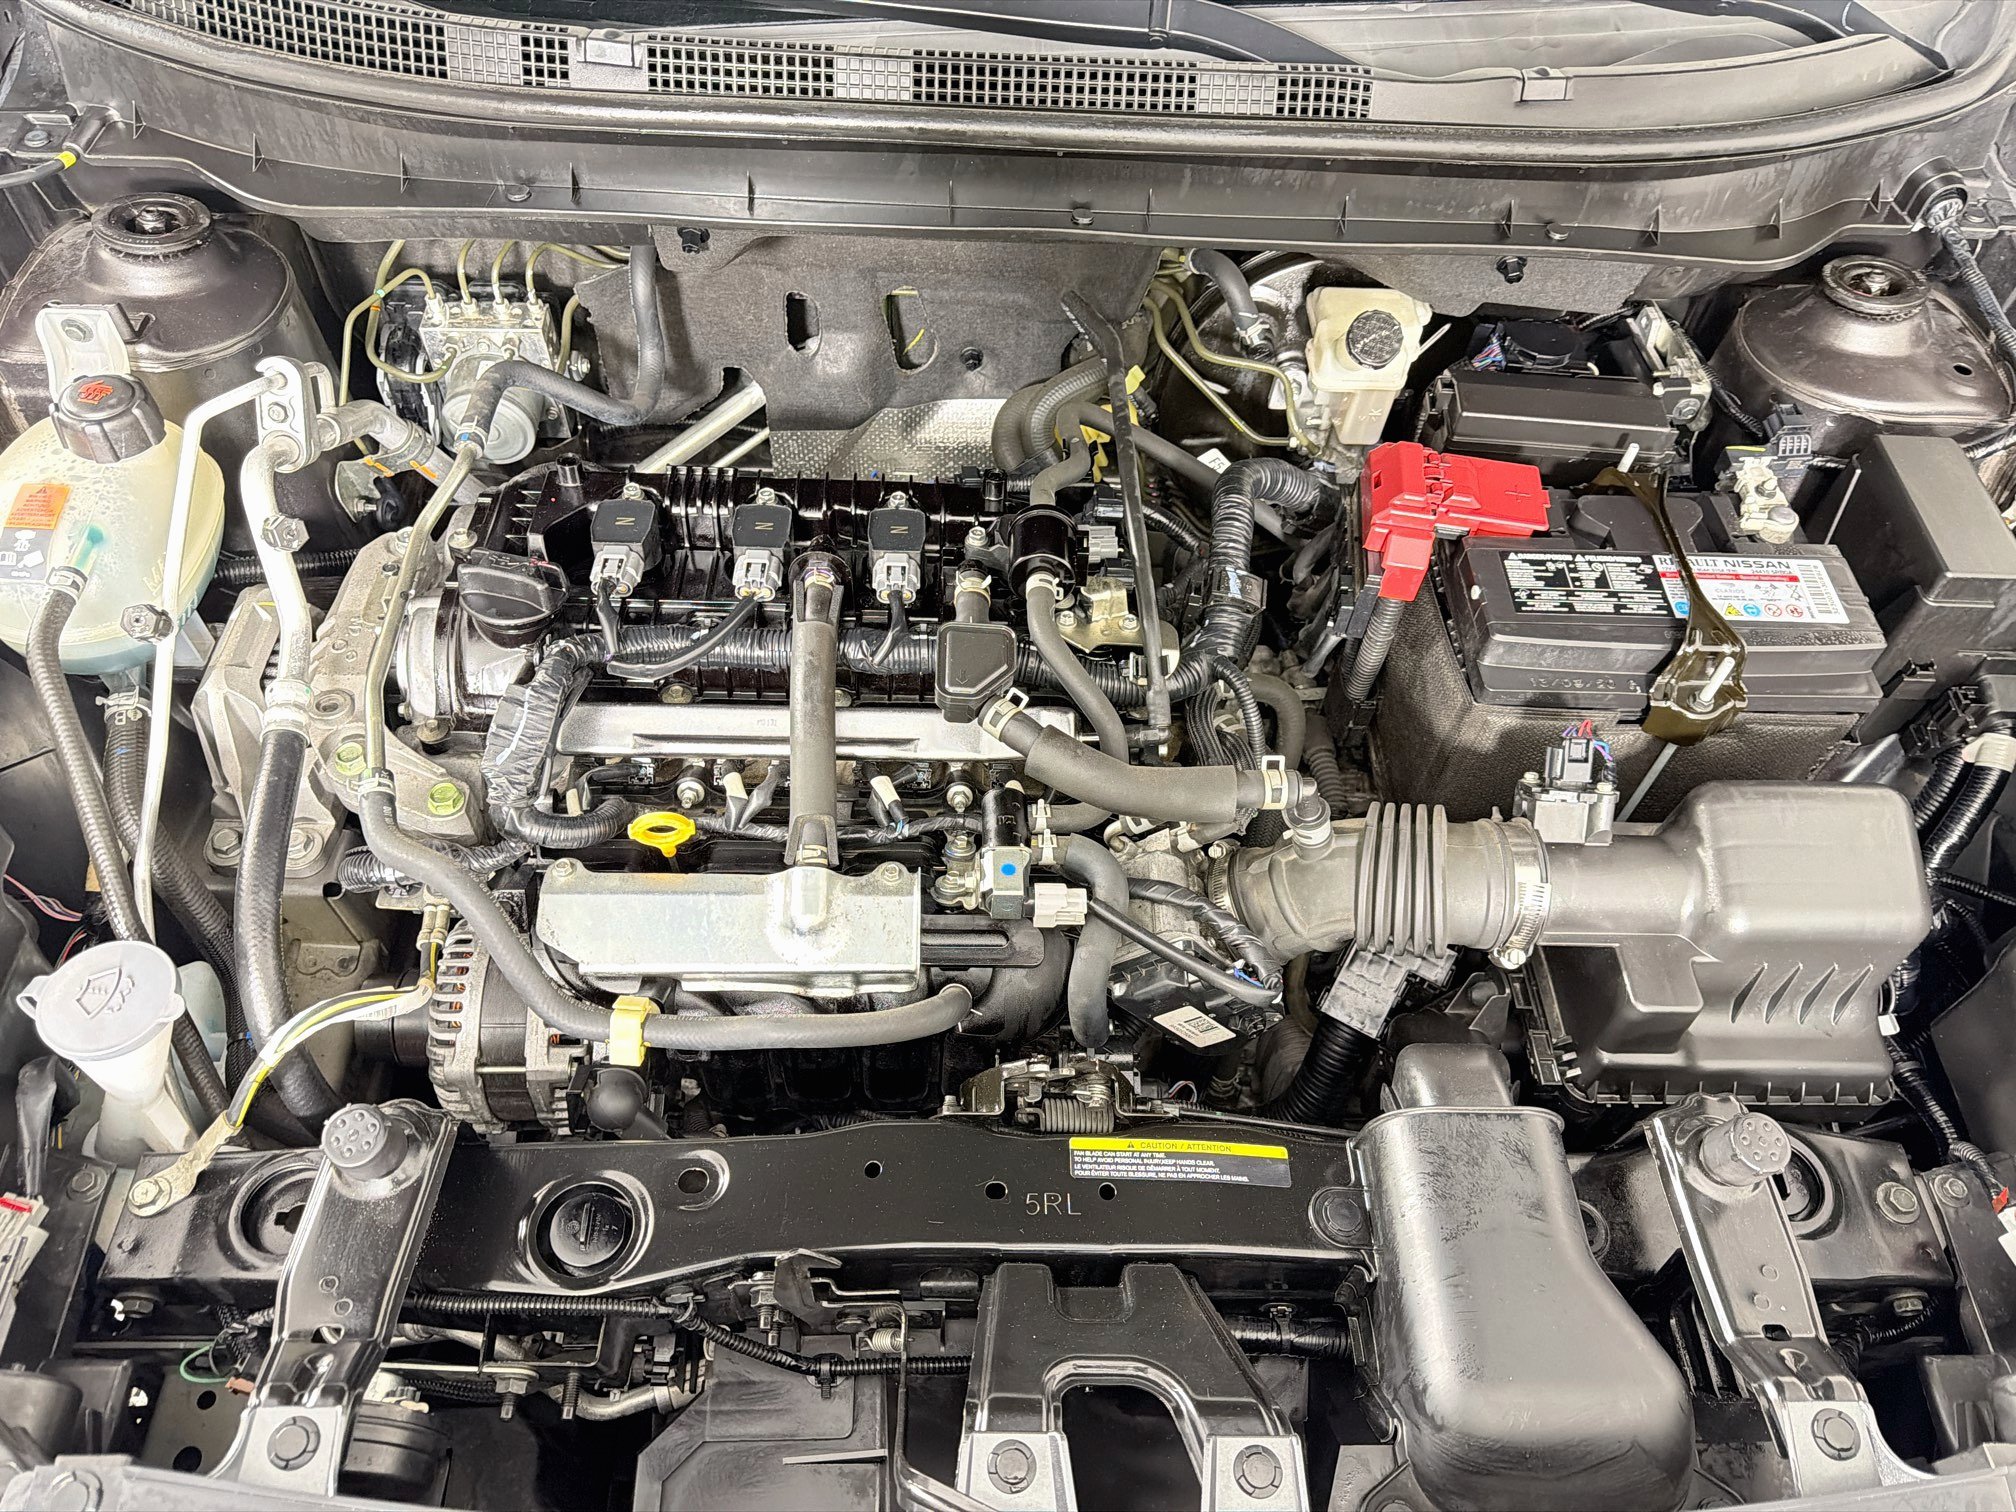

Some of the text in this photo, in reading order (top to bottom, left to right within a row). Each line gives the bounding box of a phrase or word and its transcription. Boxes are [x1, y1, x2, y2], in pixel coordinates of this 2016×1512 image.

[1723, 559, 1791, 569] NISSAN
[1140, 1142, 1178, 1150] CAUTION
[1186, 1143, 1232, 1153] ATTENTION
[1025, 1192, 1082, 1216] 5RL
